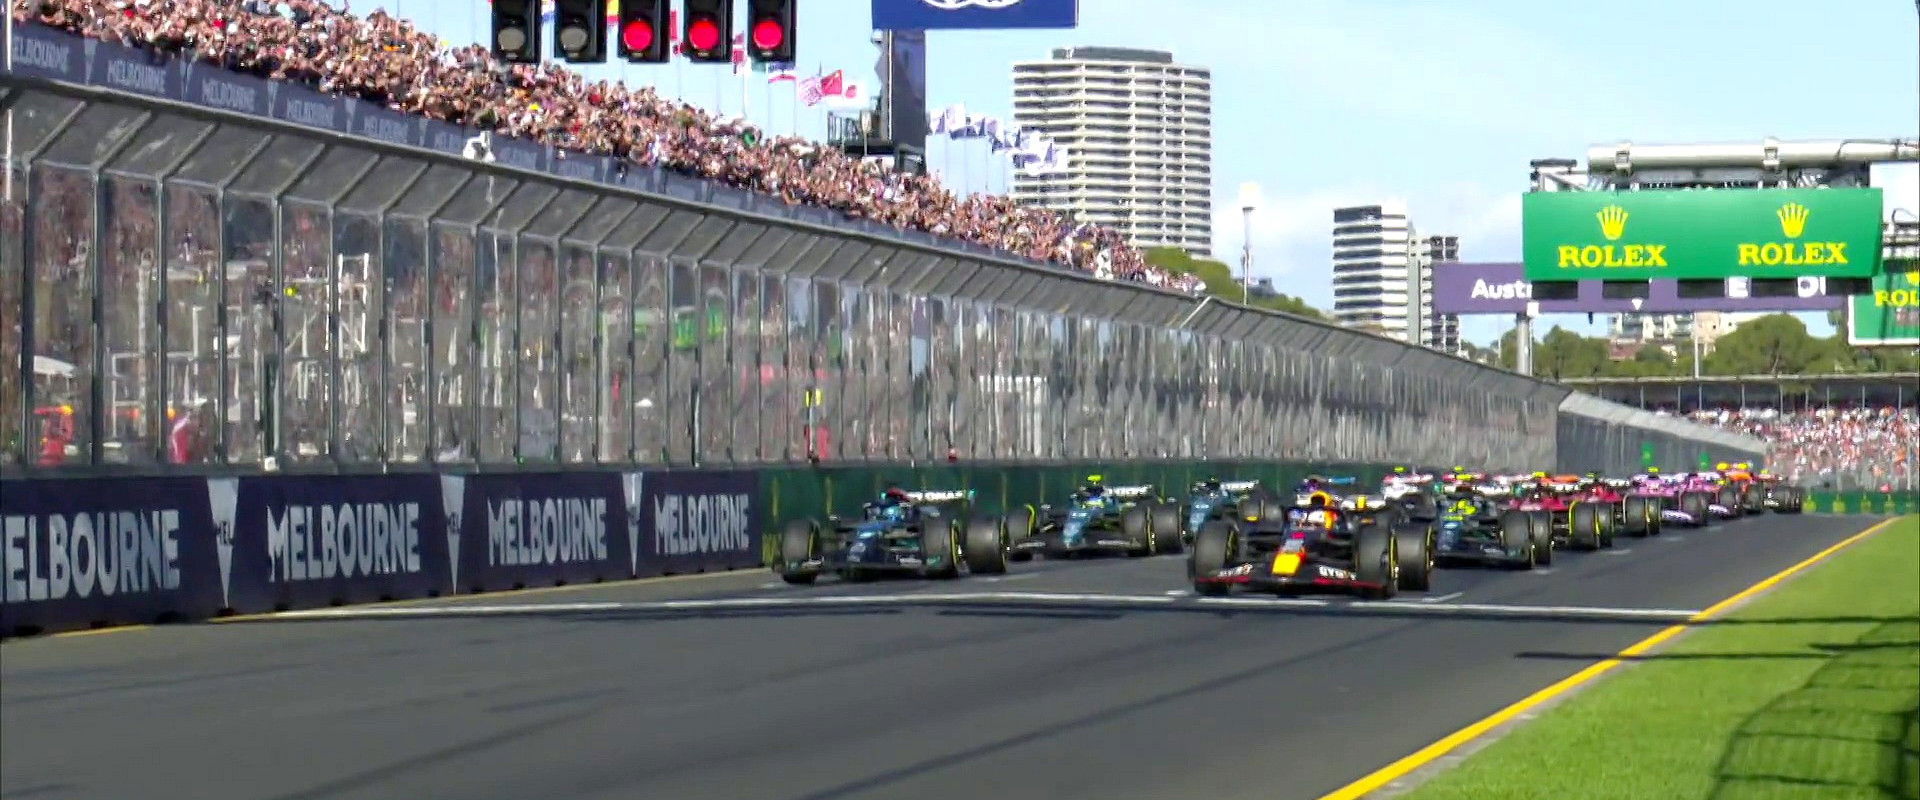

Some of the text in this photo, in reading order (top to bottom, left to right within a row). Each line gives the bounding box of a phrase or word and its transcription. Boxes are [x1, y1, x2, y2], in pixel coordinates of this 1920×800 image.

[11, 36, 70, 75] ELBOURNE
[1558, 244, 1668, 268] ROLEX
[1737, 243, 1848, 266] ROLEX
[267, 502, 421, 583] MELBOURNE
[487, 497, 607, 567] MELBOURNE
[654, 493, 750, 555] MELBOURNE
[0, 508, 180, 603] ELBOURNE
